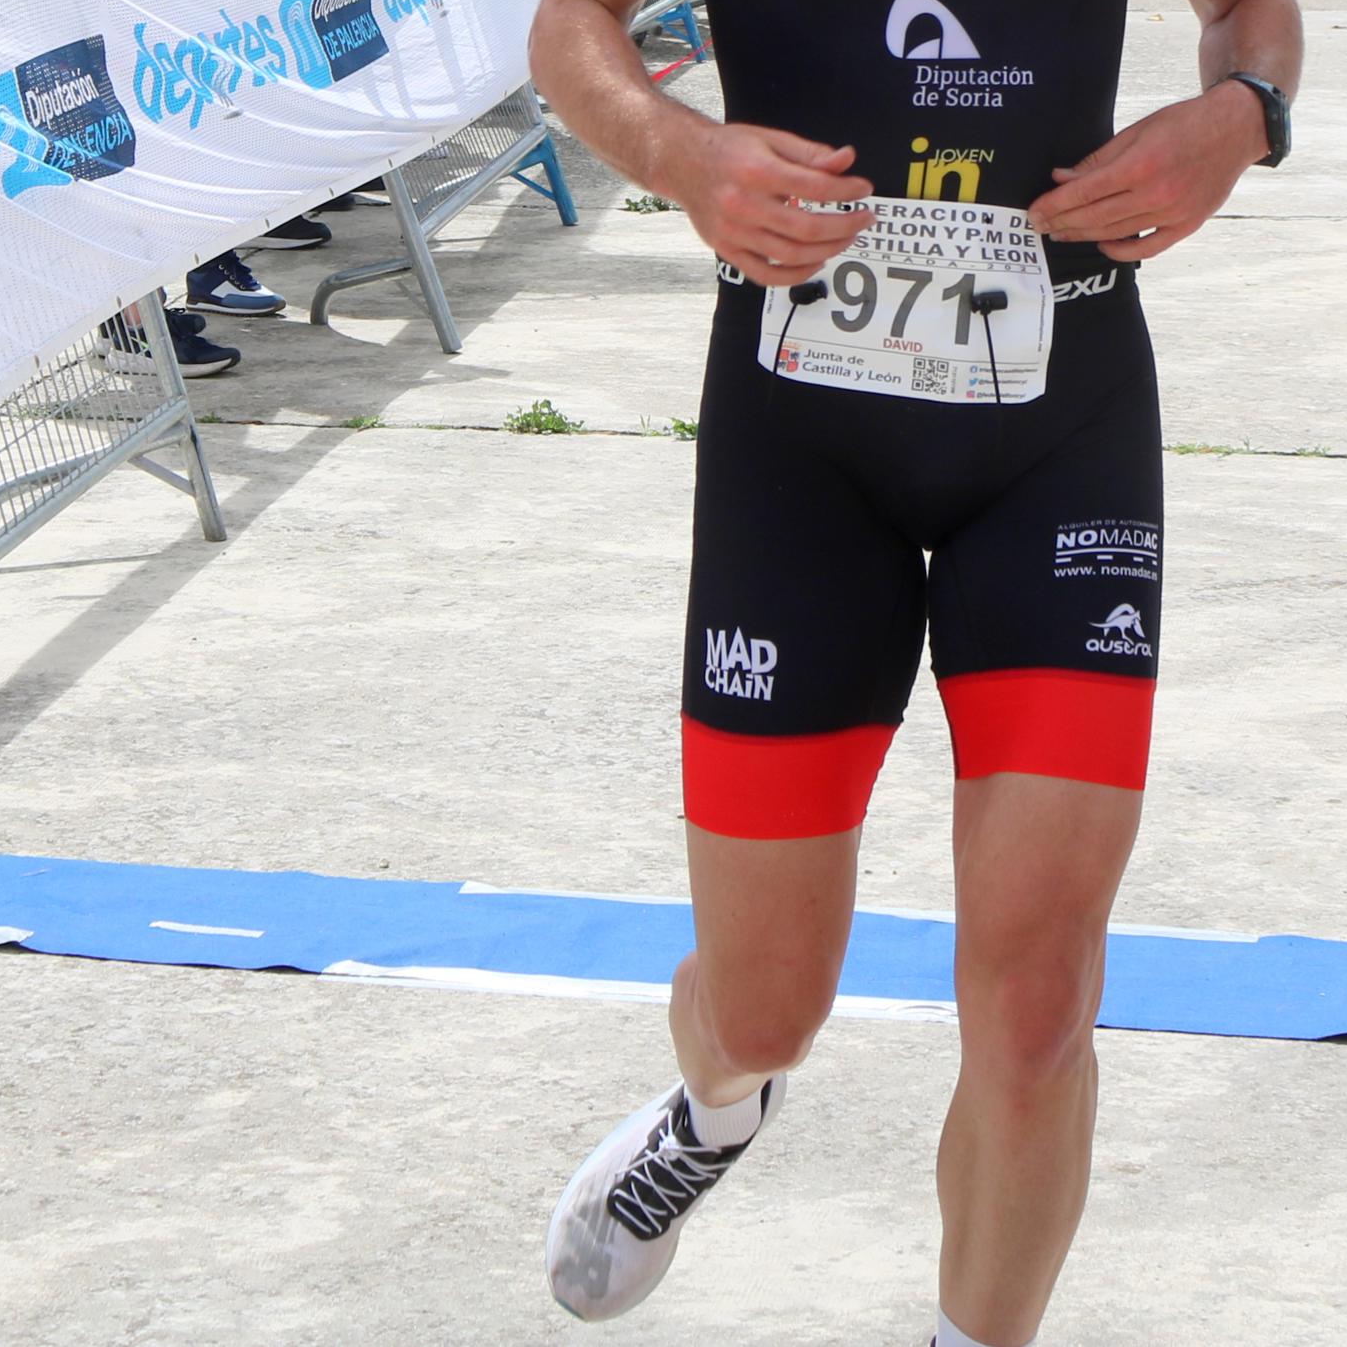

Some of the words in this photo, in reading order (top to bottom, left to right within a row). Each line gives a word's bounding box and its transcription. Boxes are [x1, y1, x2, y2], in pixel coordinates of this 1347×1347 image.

[323, 33, 343, 62] DE
[341, 11, 379, 54] PALENCIA
[914, 64, 1034, 91] Diputación
[24, 70, 99, 129] Diputación
[912, 87, 940, 108] de
[945, 88, 1004, 108] Soria
[933, 147, 995, 167] JOVEN
[906, 136, 982, 203] in
[942, 226, 960, 241] Y
[1009, 232, 1038, 249] DE
[954, 244, 972, 259] Y
[981, 247, 1039, 265] LEON
[831, 260, 976, 347] 971
[803, 348, 849, 363] Junta
[849, 354, 865, 367] de
[882, 337, 924, 354] DAVID
[802, 360, 854, 378] Castilla
[853, 368, 864, 382] y
[867, 369, 902, 385] León
[1055, 528, 1159, 550] NOMADAC
[706, 625, 778, 674] MAD
